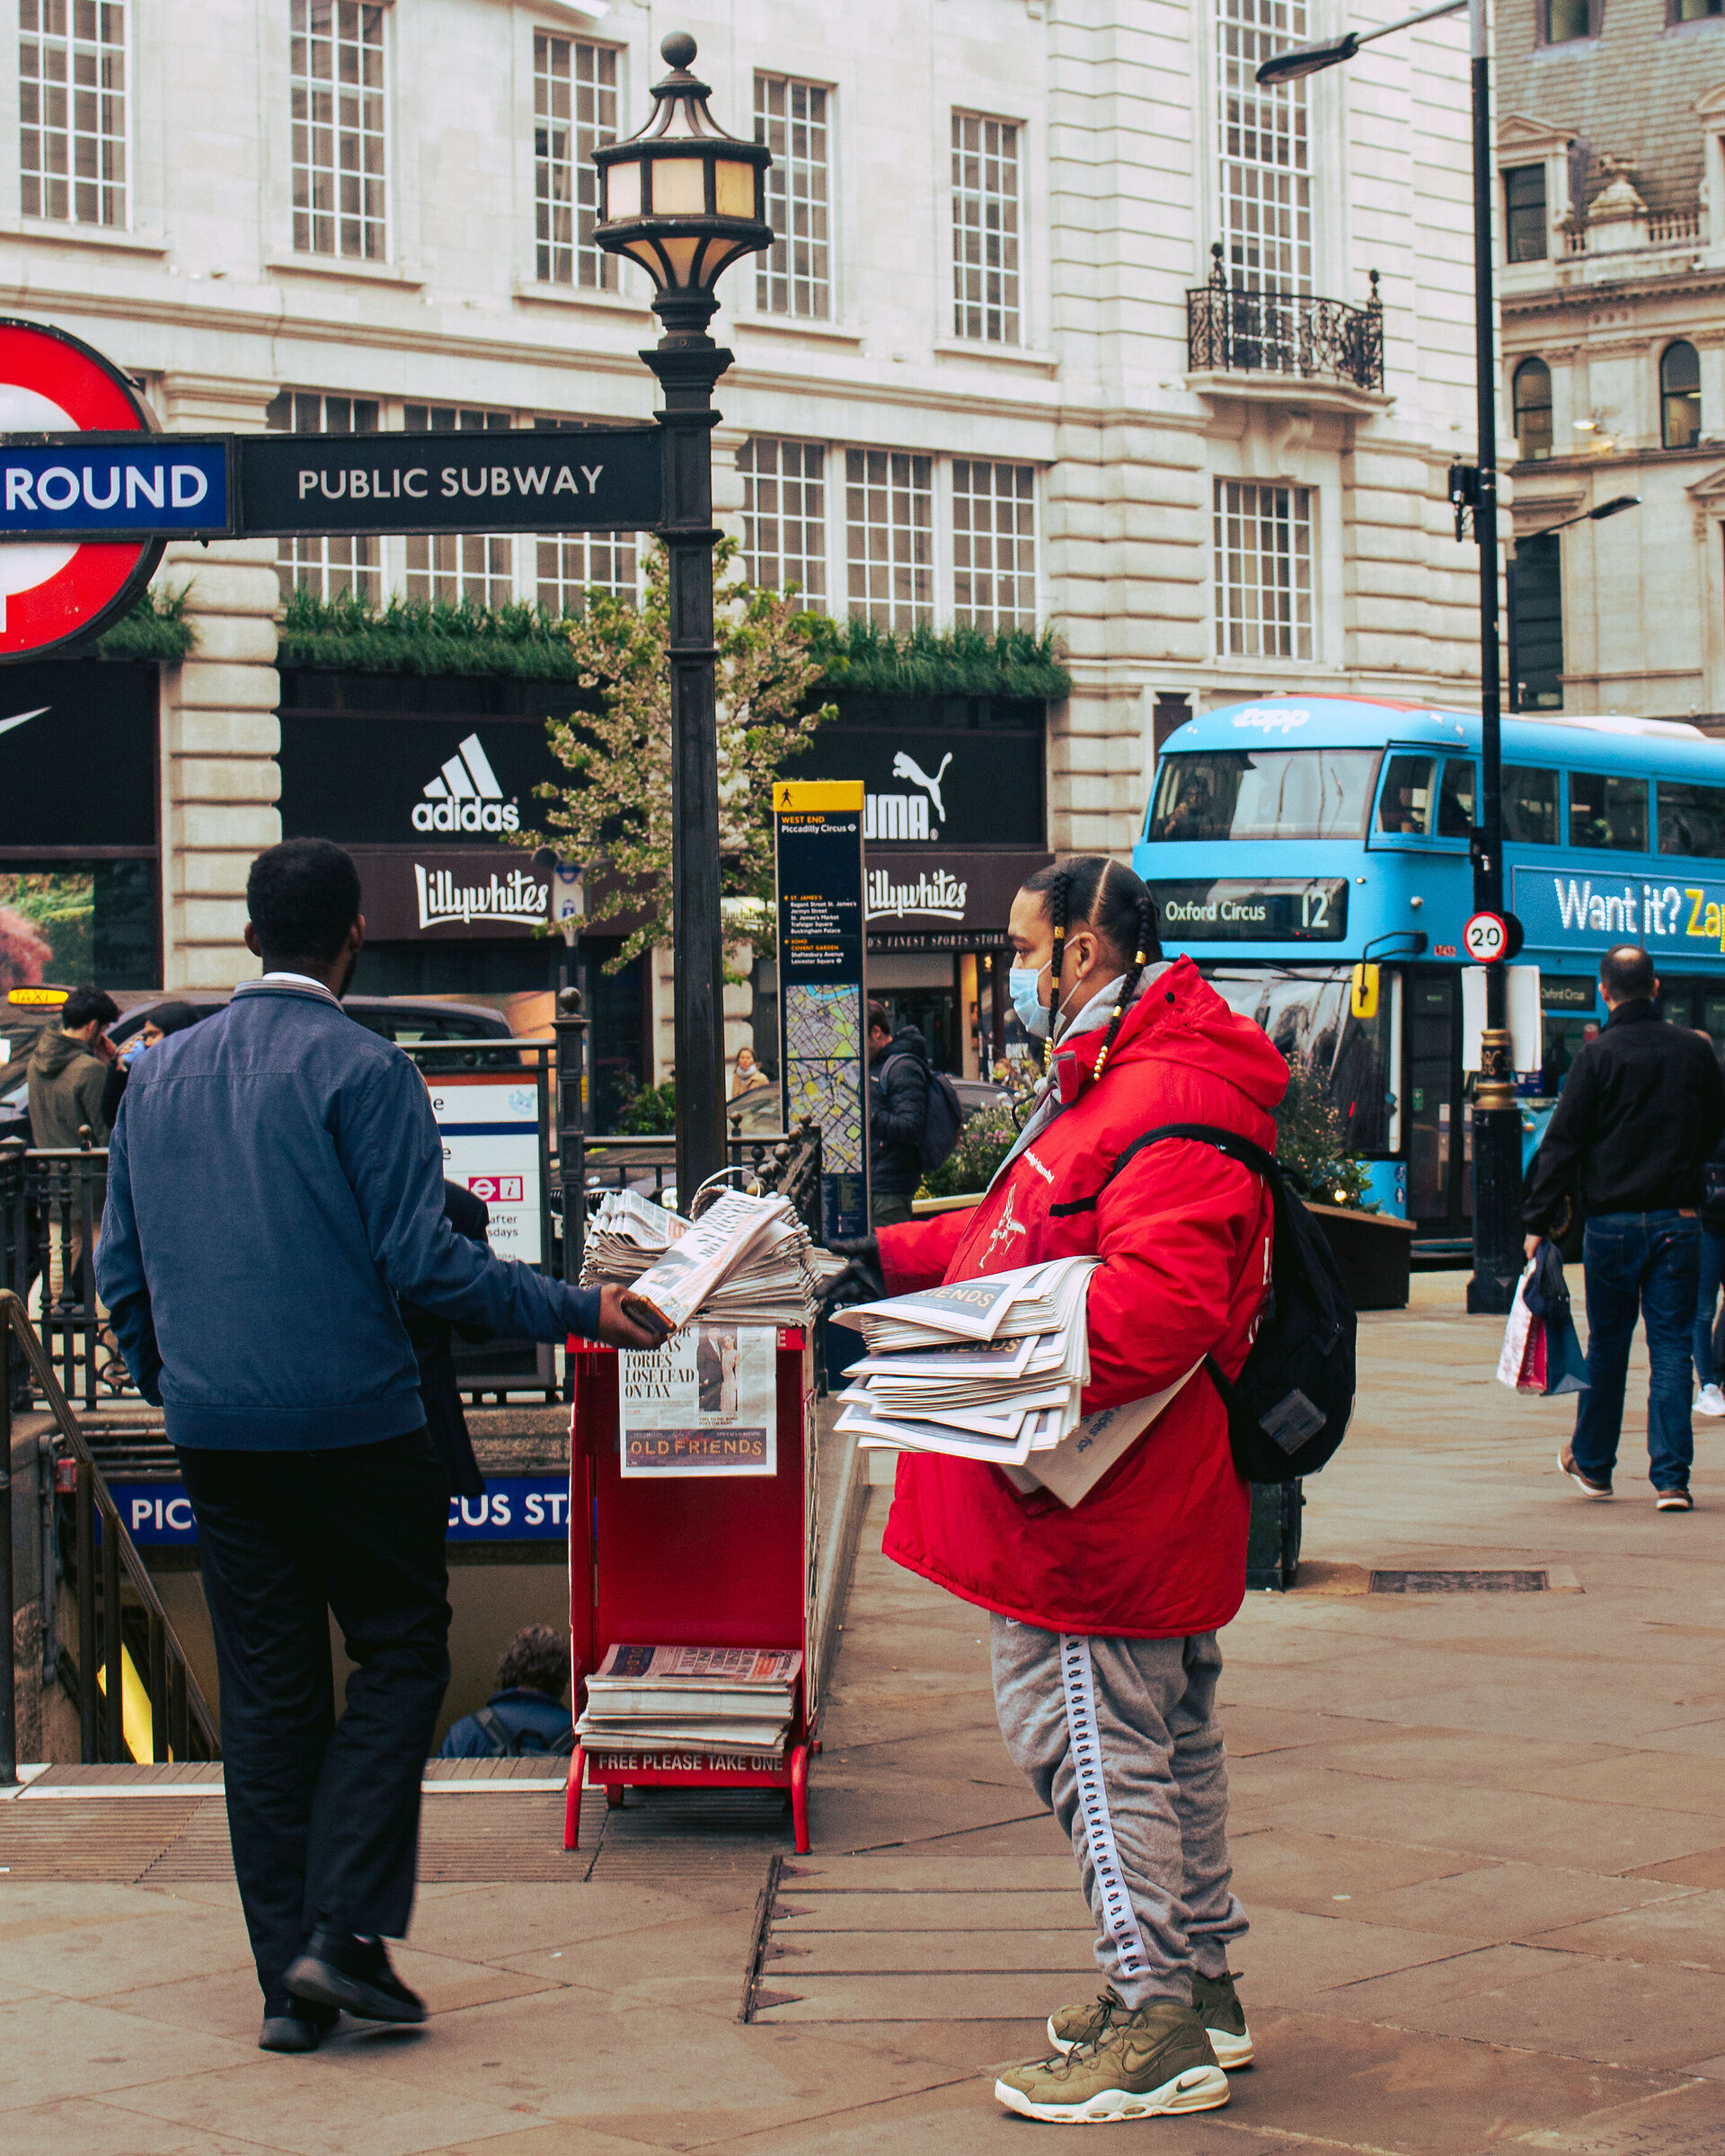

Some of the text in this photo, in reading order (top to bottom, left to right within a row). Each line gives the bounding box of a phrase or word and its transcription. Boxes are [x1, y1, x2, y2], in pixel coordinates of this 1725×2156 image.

[5, 464, 208, 511] ROUND
[298, 464, 604, 499] PUBLIC SUBWAY
[411, 795, 520, 832] adidas
[781, 815, 826, 824] WEST END
[781, 824, 847, 834] Piccadilly Circus
[413, 862, 549, 929] Lillywhites
[1164, 889, 1330, 928] Oxford Circus 12
[1553, 878, 1725, 953] Want it? Za
[887, 934, 925, 947] FINEST
[931, 933, 969, 946] SPORTS
[974, 932, 1006, 944] STORE
[1472, 927, 1501, 947] 20
[13, 989, 49, 1002] TAXI
[1540, 987, 1586, 1001] Oxford Circus
[624, 1354, 673, 1368] TORIES
[624, 1368, 695, 1383] LOSE LEAD
[624, 1383, 671, 1398] ON TAX
[630, 1439, 763, 1456] OLD FRIENDS
[132, 1498, 197, 1530] PIC
[524, 1493, 571, 1526] ST
[598, 1753, 783, 1772] FREE PLEASE TAKE ONE
